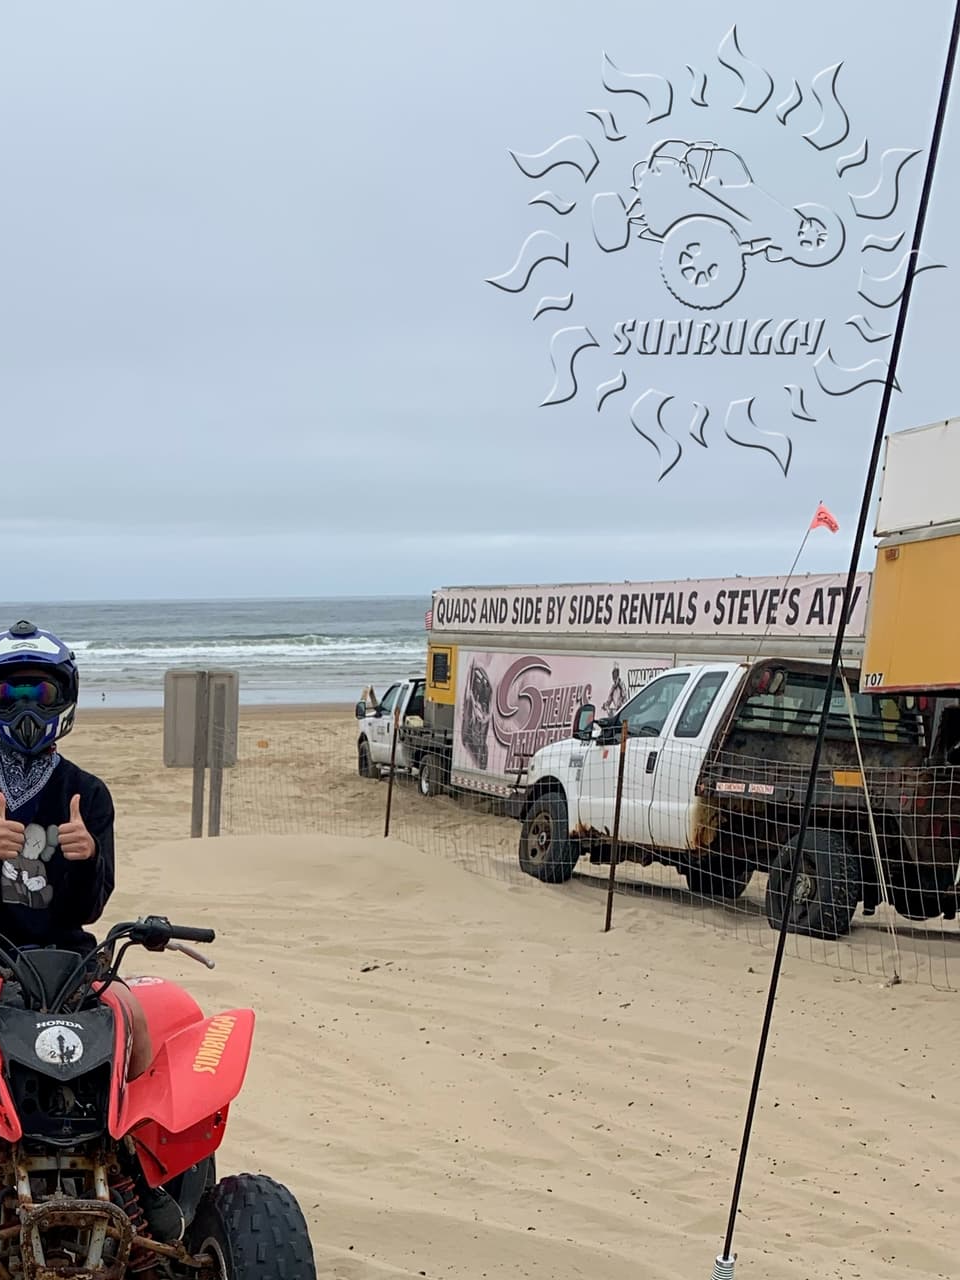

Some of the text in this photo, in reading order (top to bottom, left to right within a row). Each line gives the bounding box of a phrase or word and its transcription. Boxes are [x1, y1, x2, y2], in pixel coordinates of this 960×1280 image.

[437, 598, 476, 625] QUADS
[479, 598, 508, 624] AND
[512, 597, 542, 625] SIDE
[546, 596, 566, 625] BY
[568, 594, 613, 625] SIDES
[618, 591, 697, 625] RENTALS
[713, 588, 800, 626] STEVE'S
[36, 1020, 84, 1030] HONDA
[192, 1015, 237, 1075] SUNBUGGY
